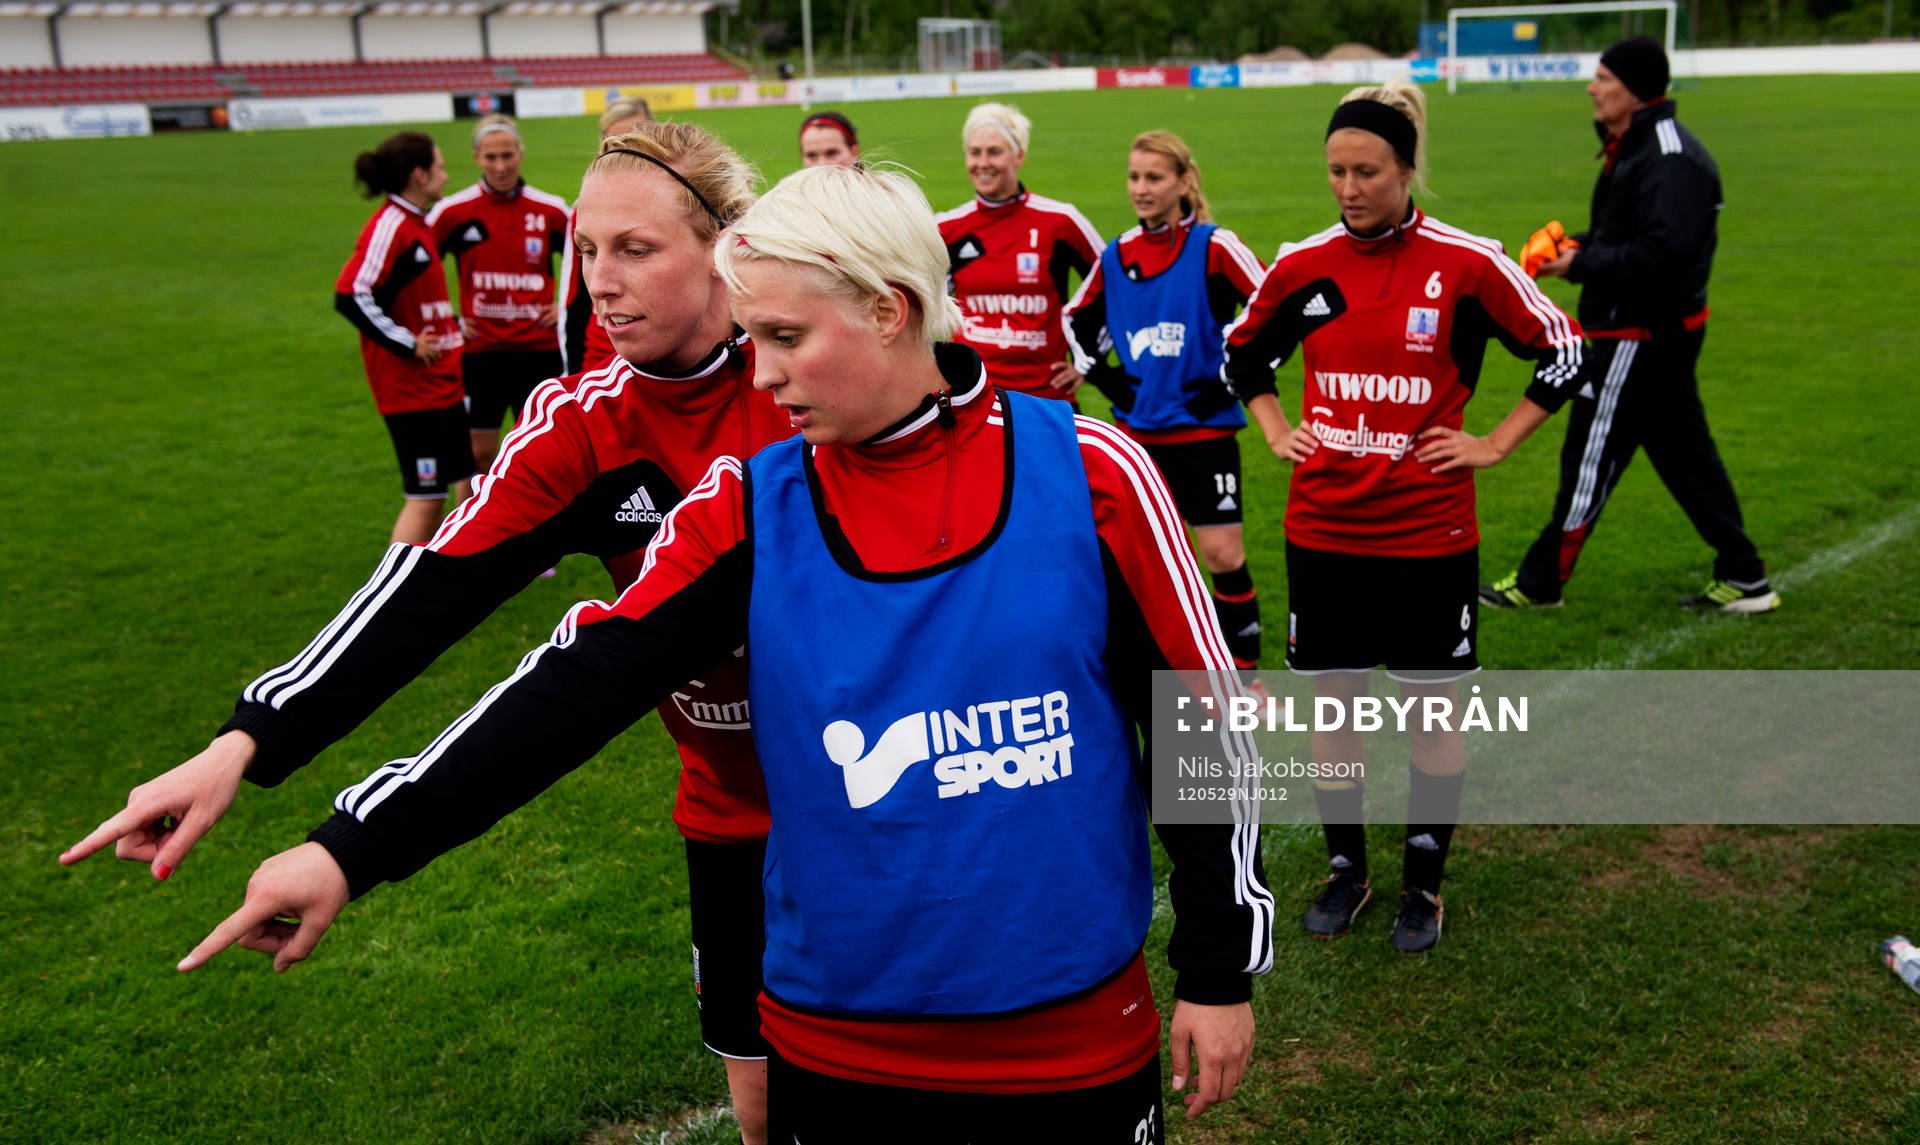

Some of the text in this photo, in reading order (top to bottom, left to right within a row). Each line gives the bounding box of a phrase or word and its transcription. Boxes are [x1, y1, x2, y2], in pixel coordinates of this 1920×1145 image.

[525, 213, 546, 232] 24
[1028, 227, 1039, 249] 1
[1424, 270, 1443, 299] 6
[1213, 472, 1237, 495] 18
[614, 509, 663, 523] adidas
[1460, 604, 1471, 631] 6
[929, 690, 1070, 755] INTER
[933, 733, 1075, 799] SPORT
